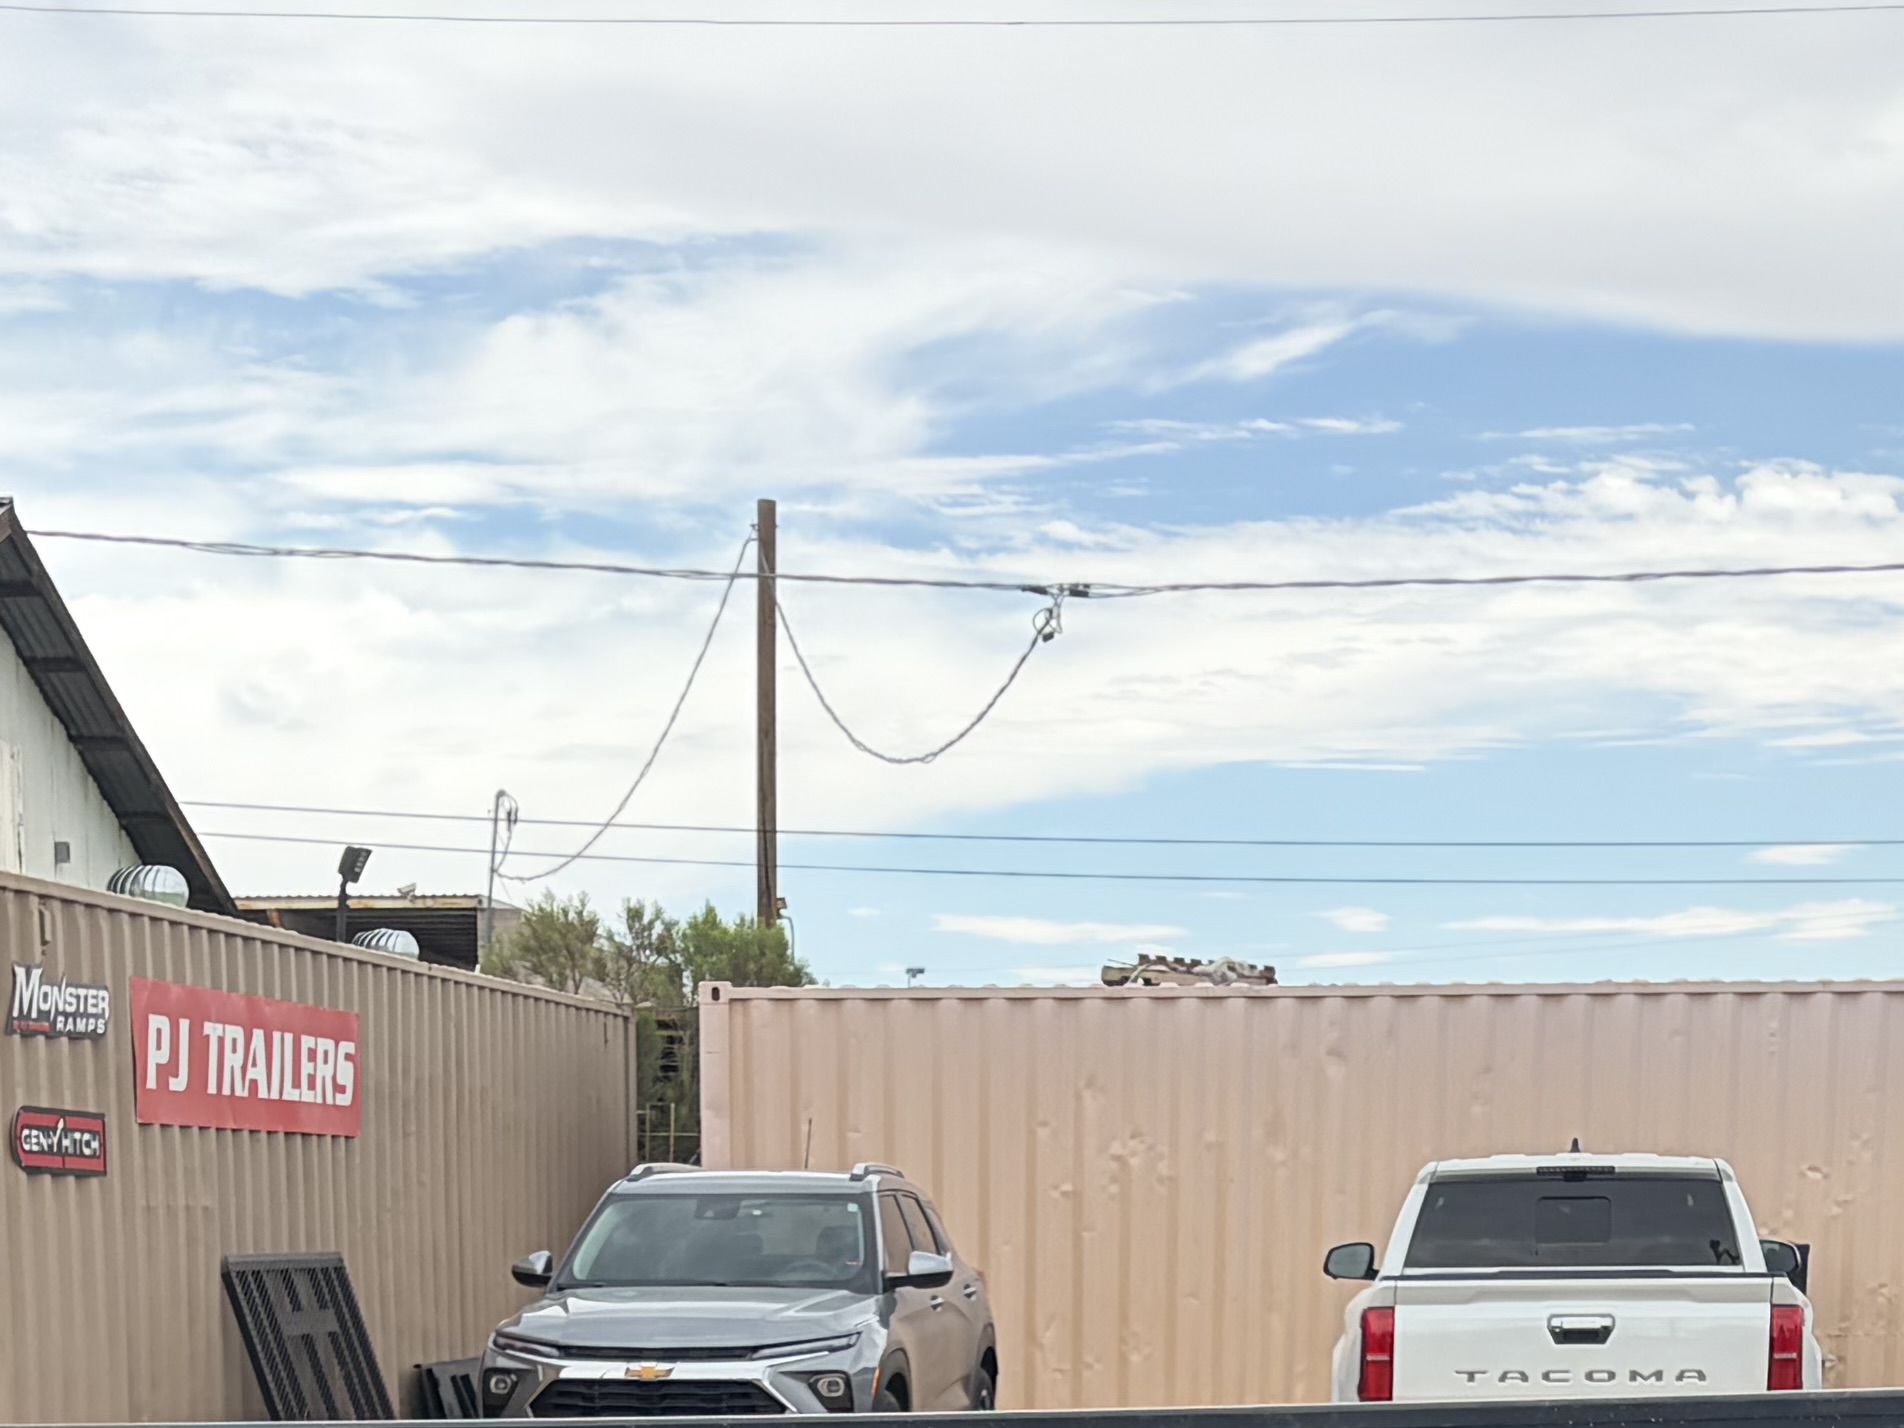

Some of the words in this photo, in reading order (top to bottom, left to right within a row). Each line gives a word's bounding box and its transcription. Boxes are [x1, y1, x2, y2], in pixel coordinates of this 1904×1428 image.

[12, 965, 109, 1019] MONSTER
[56, 1016, 106, 1035] RAMPS
[145, 1013, 190, 1092] PJ
[203, 1021, 356, 1106] TRAILERS
[62, 1132, 100, 1156] HITCH
[1454, 1369, 1707, 1383] TACOMA
